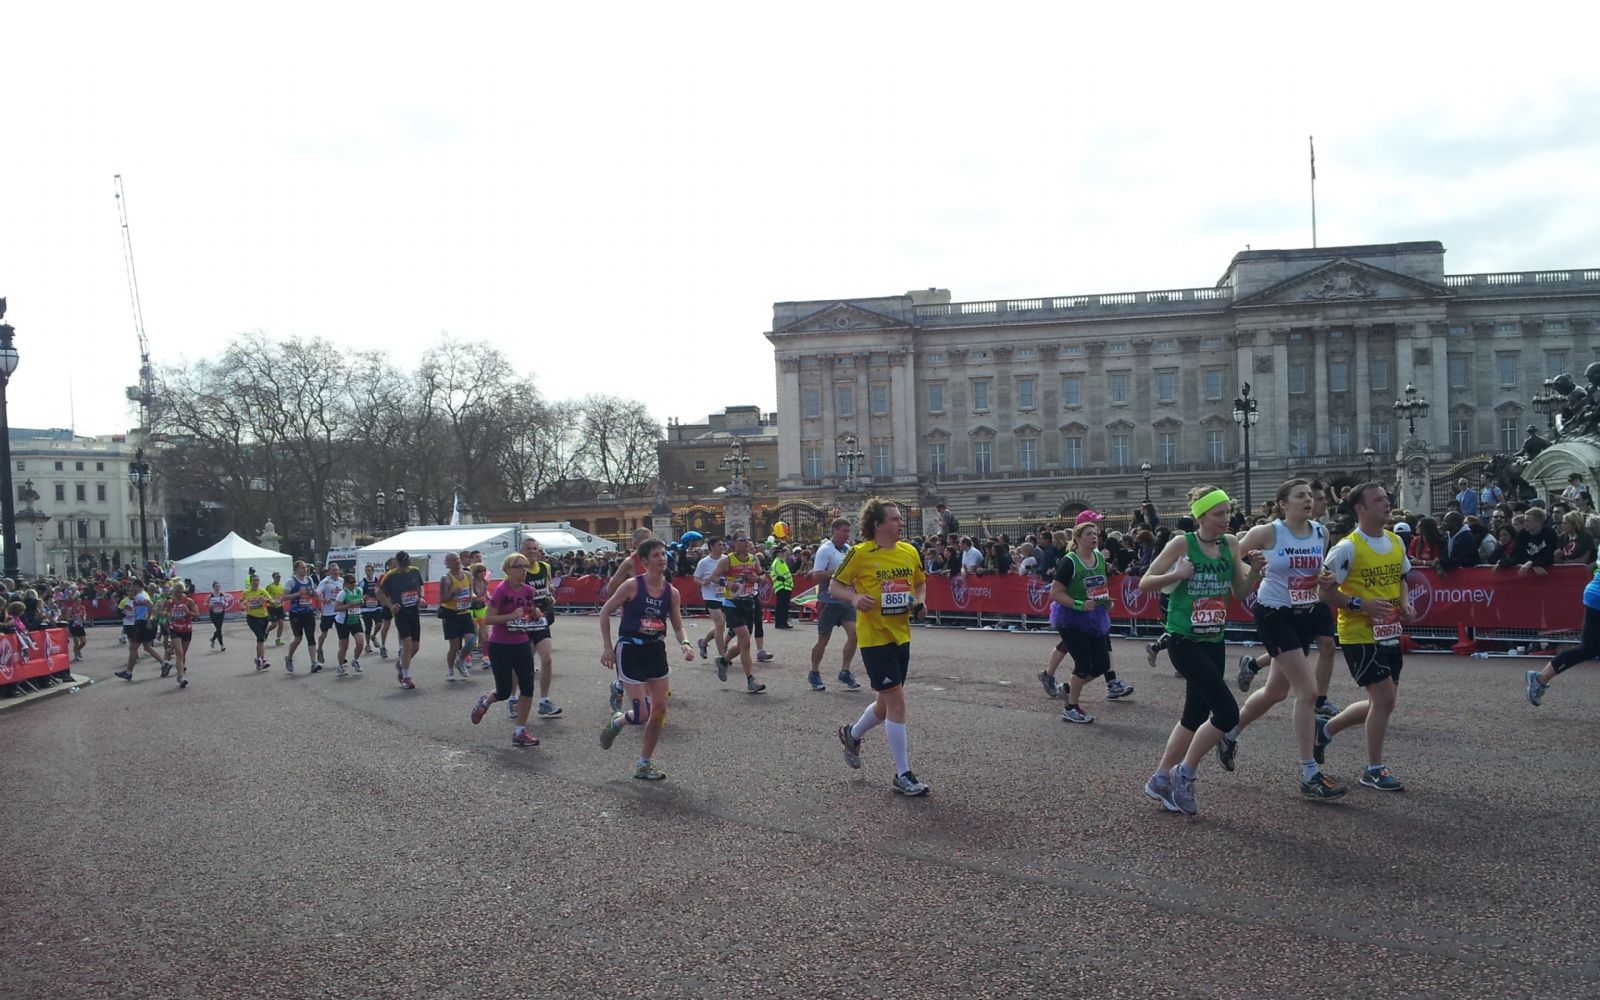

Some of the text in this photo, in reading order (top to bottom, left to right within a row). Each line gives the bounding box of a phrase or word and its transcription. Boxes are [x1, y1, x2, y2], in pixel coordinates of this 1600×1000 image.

[1289, 556, 1322, 569] JENNY
[1360, 562, 1401, 578] CHILDRE
[1364, 578, 1376, 587] IN
[885, 593, 907, 605] 8651
[969, 587, 992, 599] money
[1434, 588, 1494, 607] money
[645, 596, 663, 607] LUCY
